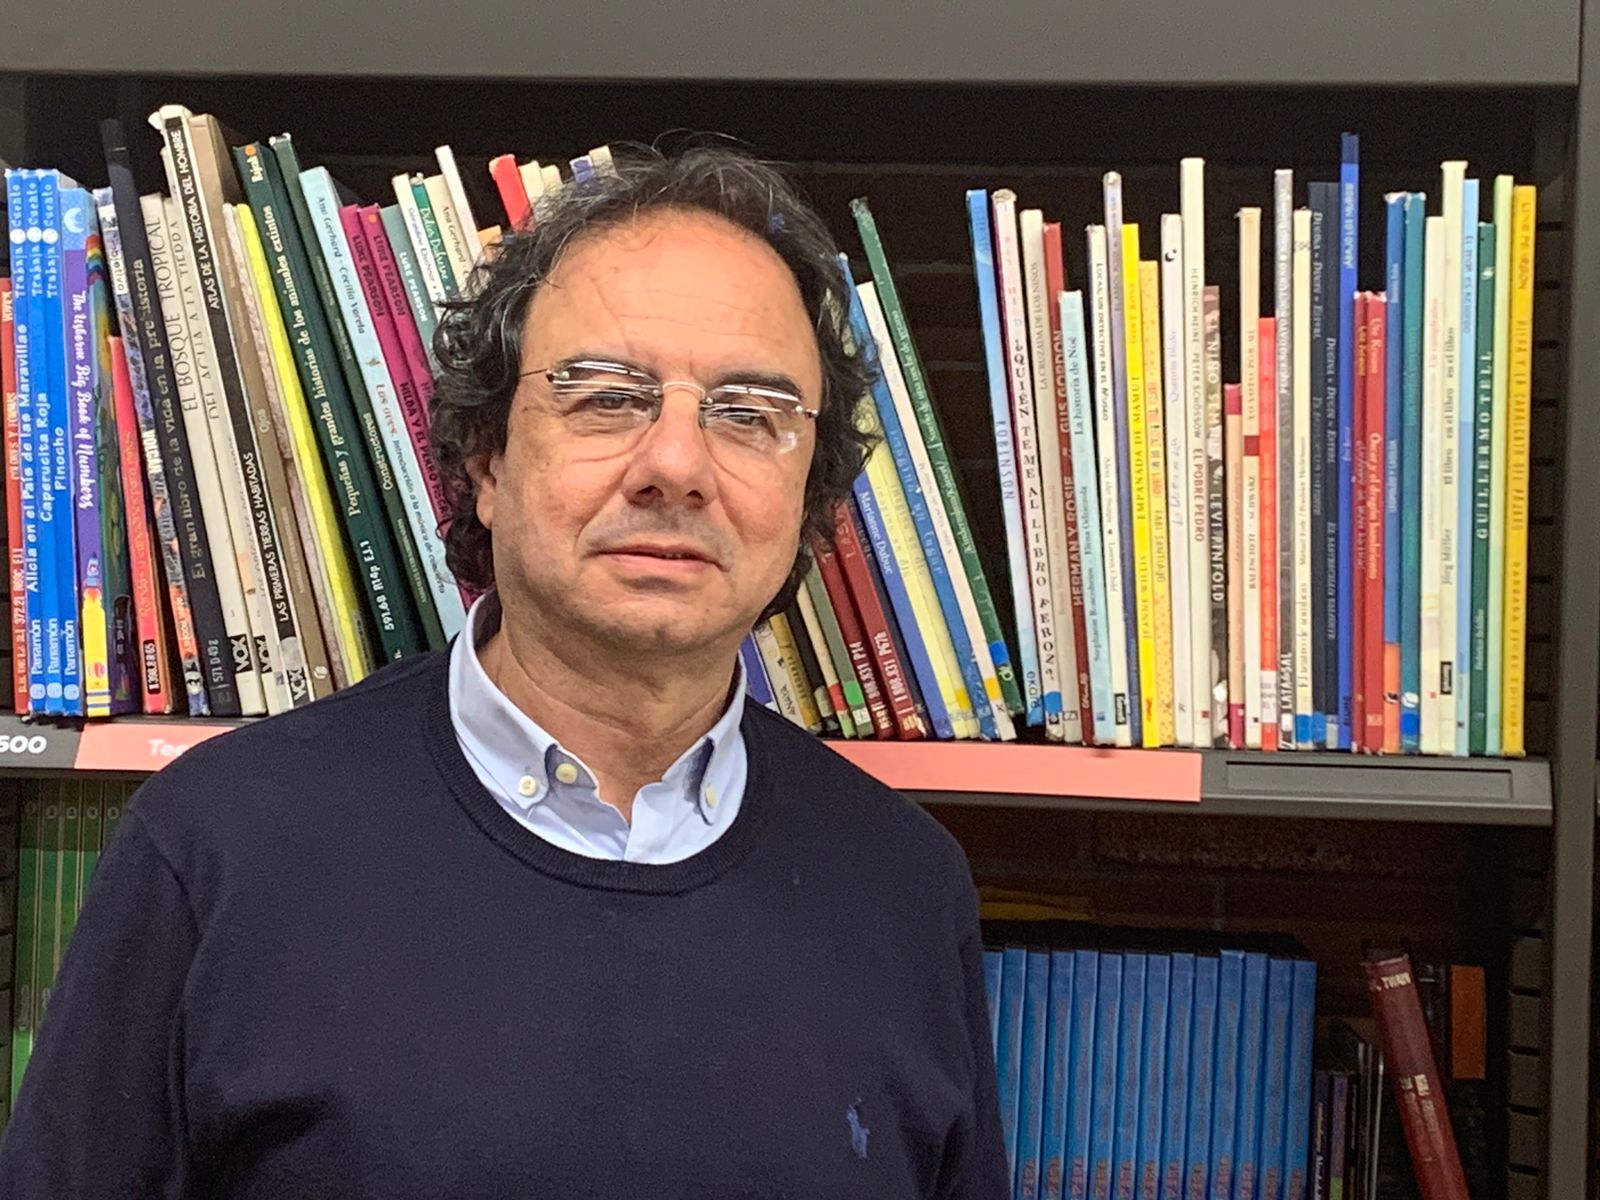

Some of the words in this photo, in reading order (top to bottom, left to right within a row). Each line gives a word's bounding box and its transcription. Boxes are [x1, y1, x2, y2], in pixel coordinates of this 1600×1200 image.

[170, 130, 190, 172] HOMBRE
[184, 176, 197, 194] DEL
[12, 184, 22, 227] Cuento
[28, 182, 38, 226] Cuento
[44, 184, 54, 227] Cuento
[188, 196, 208, 242] HISTORIA
[263, 206, 284, 252] extintos
[30, 244, 42, 296] Trabaja
[144, 216, 175, 300] TROPICAL
[198, 245, 210, 260] LA
[202, 262, 214, 276] DE
[323, 218, 342, 258] Gerhard
[338, 266, 356, 300] Cecilia
[14, 247, 24, 298] Trabaja
[46, 247, 58, 298] Trabaja
[276, 254, 300, 306] animales
[382, 264, 405, 316] PEARSON
[399, 252, 413, 277] LUKE
[410, 278, 428, 322] PEARSON
[1313, 262, 1324, 294] DUGIN
[72, 291, 88, 312] The
[206, 278, 220, 310] ATLAS
[362, 264, 384, 318] PEARSON
[292, 309, 307, 326] los
[1370, 318, 1381, 336] Ute
[166, 313, 196, 387] BOSQUE
[298, 329, 310, 346] de
[1067, 336, 1078, 358] Noé
[1446, 327, 1454, 352] libro
[305, 348, 327, 399] historias
[1052, 330, 1067, 398] GORDON
[1068, 360, 1079, 374] de
[1100, 361, 1106, 372] EN
[1370, 338, 1381, 374] Krause
[1446, 366, 1454, 378] en
[72, 364, 93, 388] Big
[158, 376, 169, 394] en
[1100, 374, 1108, 384] EL
[1479, 351, 1492, 404] TELL
[37, 392, 51, 428] Roja
[74, 391, 94, 425] Book
[181, 396, 198, 412] EL
[400, 382, 418, 417] HILDA
[416, 431, 426, 443] EL
[1070, 376, 1083, 417] historia
[1130, 376, 1140, 422] MAMUT
[1326, 386, 1336, 418] DUGIN
[1444, 388, 1454, 412] libro
[160, 398, 175, 433] vida
[320, 401, 344, 446] grandes
[1059, 400, 1072, 433] GUS
[1074, 420, 1084, 435] La
[1444, 414, 1454, 424] el
[1446, 426, 1454, 439] en
[72, 428, 92, 440] of
[362, 412, 394, 491] Constructores
[1132, 426, 1144, 446] DE
[22, 444, 33, 462] de
[52, 426, 66, 490] Pinocho
[172, 456, 184, 476] de
[336, 448, 349, 458] y
[996, 420, 1014, 500] ROBINSON
[1194, 448, 1204, 461] EL
[1444, 448, 1454, 472] libro
[38, 431, 54, 522] Caperucita
[78, 444, 95, 509] Numbers
[242, 452, 263, 508] HABITADAS
[338, 460, 362, 516] Pequeñas
[1134, 448, 1148, 520] EMPANADA
[1194, 464, 1204, 500] POBRE
[1370, 470, 1380, 482] el
[1444, 474, 1454, 485] El
[1476, 412, 1490, 539] GUILLERMO
[24, 506, 34, 519] el
[178, 481, 194, 519] libro
[1064, 476, 1077, 522] ROSIE
[1210, 492, 1223, 528] LEVI
[26, 524, 36, 543] en
[186, 522, 202, 558] gran
[258, 510, 274, 550] TIERRAS
[858, 491, 880, 540] Marianne
[875, 540, 894, 576] Dubuc
[1066, 526, 1079, 536] Y
[1196, 504, 1206, 542] PEDRO
[1032, 519, 1047, 587] LIBRO
[1368, 522, 1380, 579] hambriento
[1442, 528, 1453, 560] Müller
[26, 548, 38, 593] Alicia
[190, 562, 206, 579] El
[266, 551, 286, 600] PRIMERAS
[369, 564, 384, 590] R14p
[1068, 538, 1084, 606] HERMAN
[1138, 555, 1148, 592] WILLIS
[1212, 532, 1224, 602] PINFOLD
[277, 602, 289, 621] LAS
[376, 594, 394, 630] 591.68
[1140, 596, 1150, 640] JEANNE
[232, 636, 250, 672] VOX
